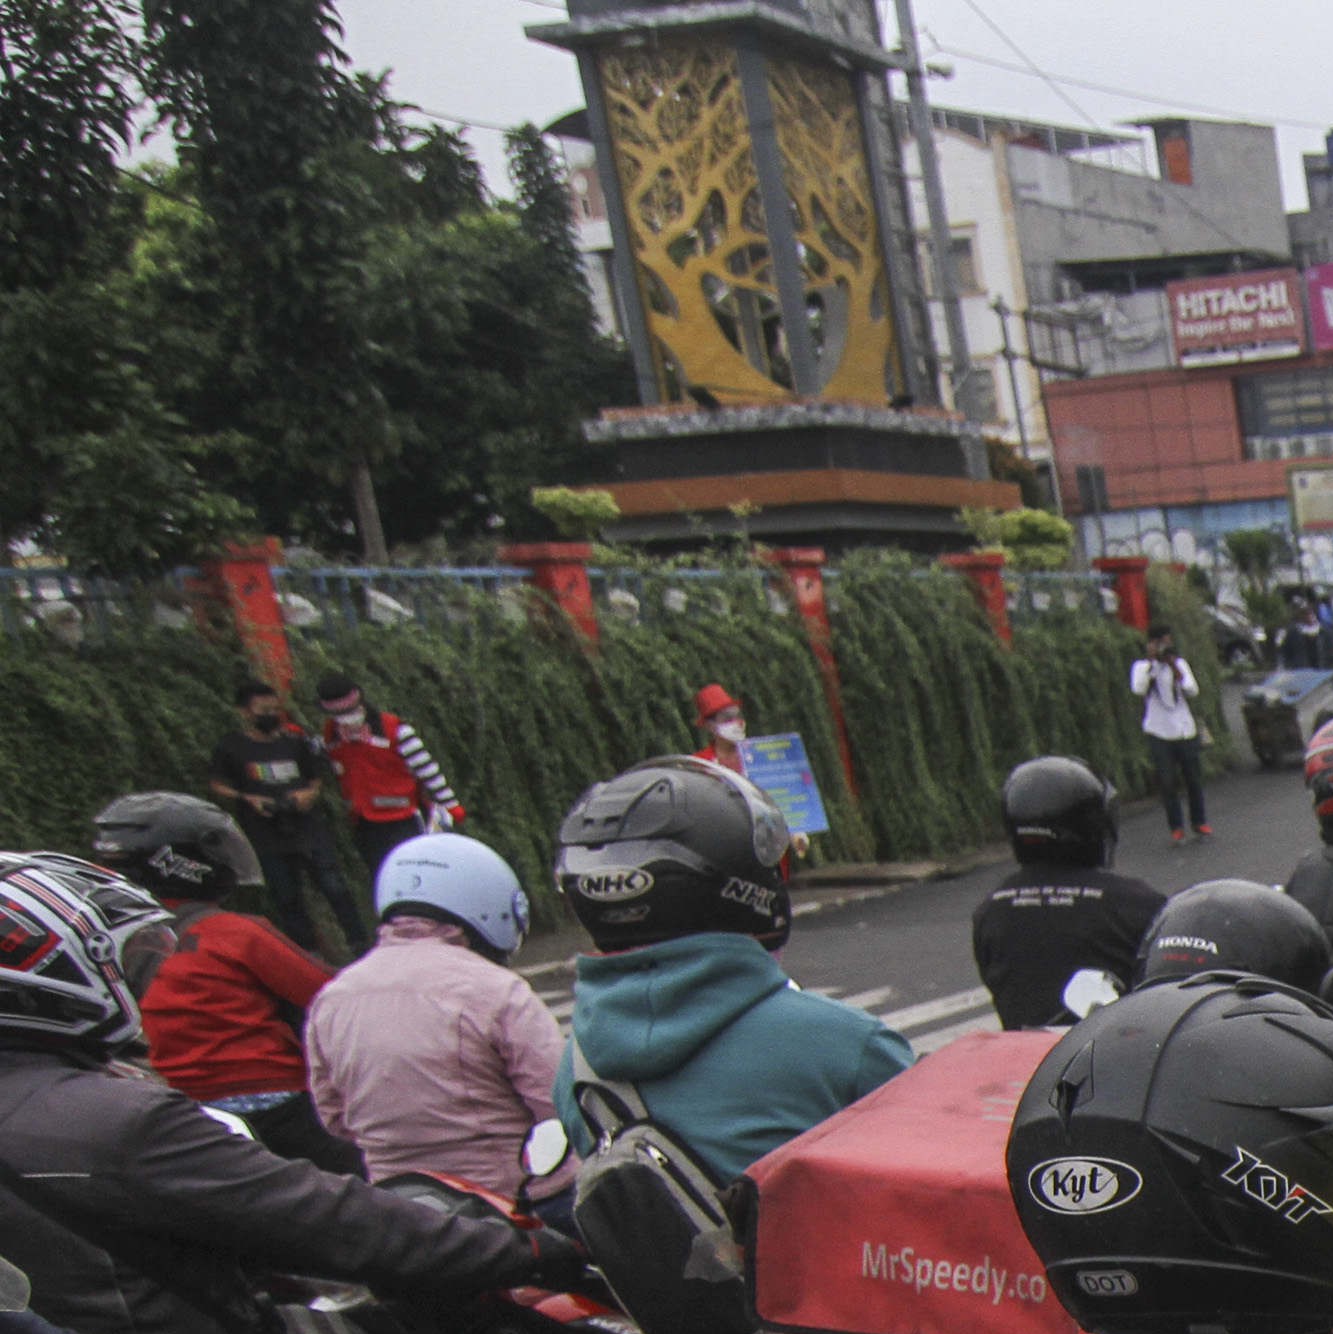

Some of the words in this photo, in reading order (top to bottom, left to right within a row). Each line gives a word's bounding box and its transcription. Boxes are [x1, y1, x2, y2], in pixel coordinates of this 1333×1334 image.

[1176, 280, 1289, 320] HITACHI
[1158, 935, 1219, 956] HONDA
[1084, 1276, 1131, 1294] DOT
